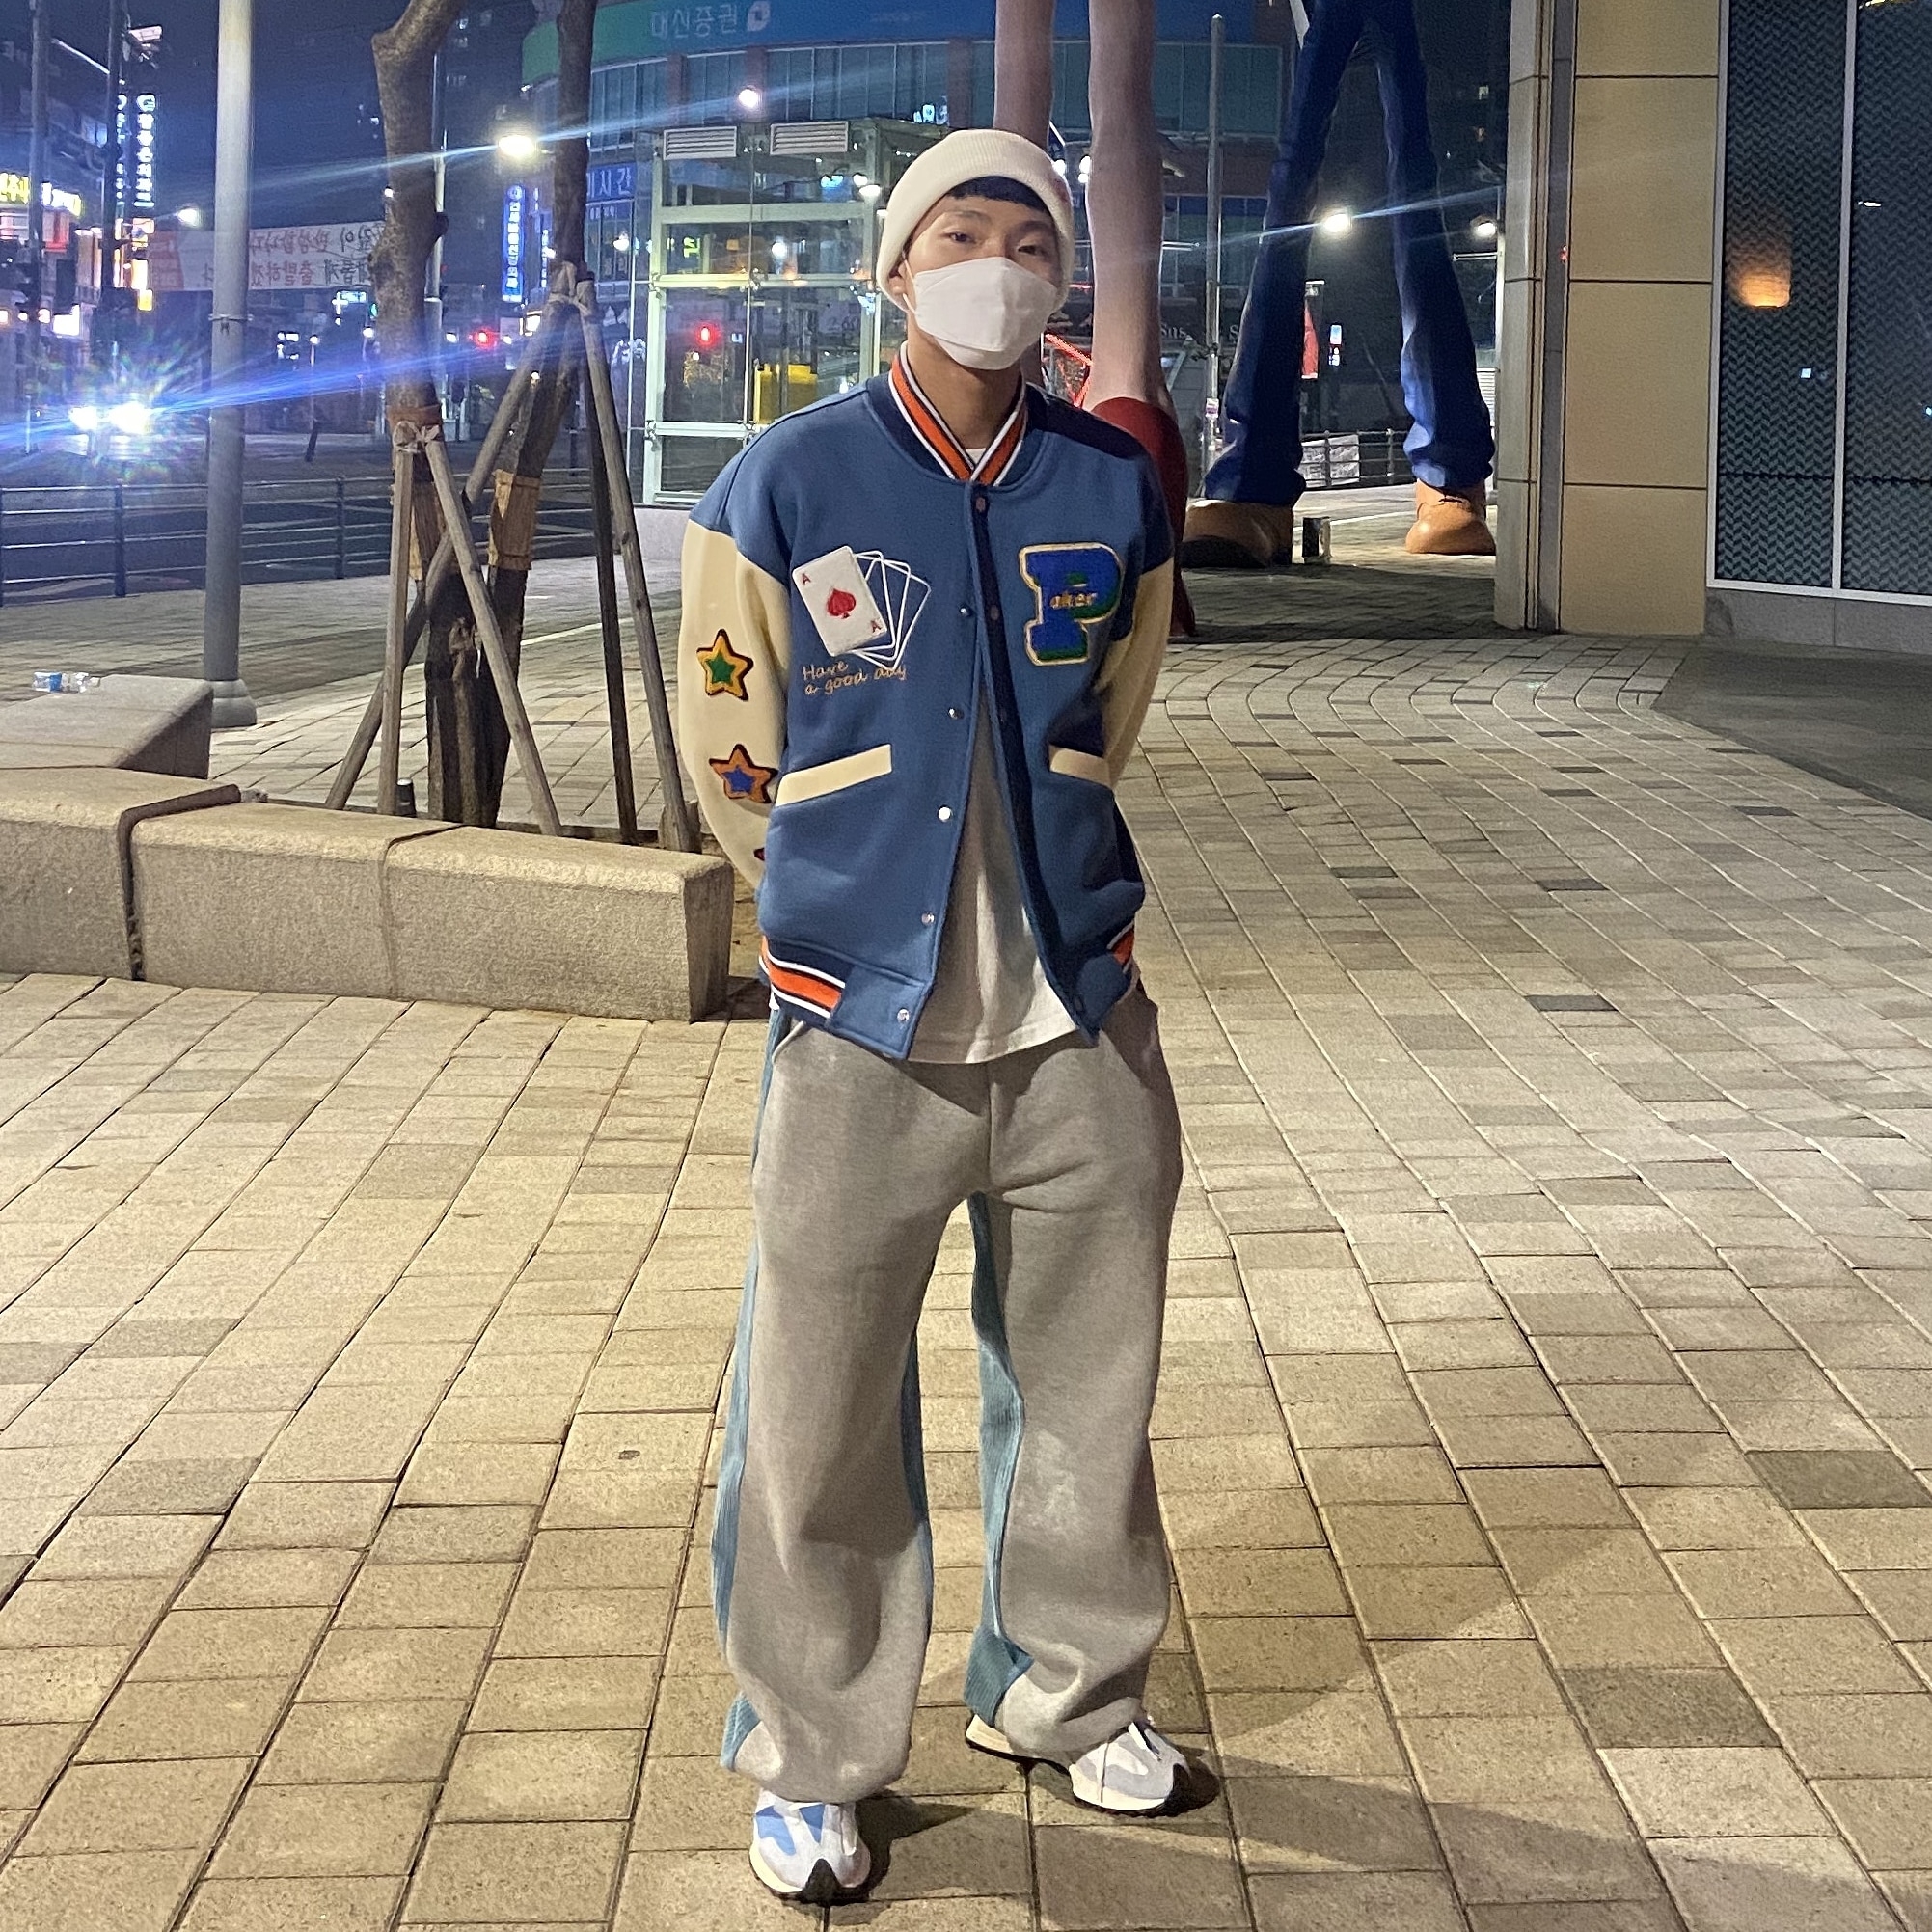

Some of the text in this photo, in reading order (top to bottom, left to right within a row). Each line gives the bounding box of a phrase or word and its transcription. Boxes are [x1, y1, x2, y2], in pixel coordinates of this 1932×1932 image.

[651, 4, 737, 39] 대신증권
[802, 572, 812, 586] A
[1019, 542, 1125, 666] P
[869, 619, 882, 634] A
[803, 661, 848, 681] Have
[804, 683, 823, 695] a
[825, 667, 869, 695] good
